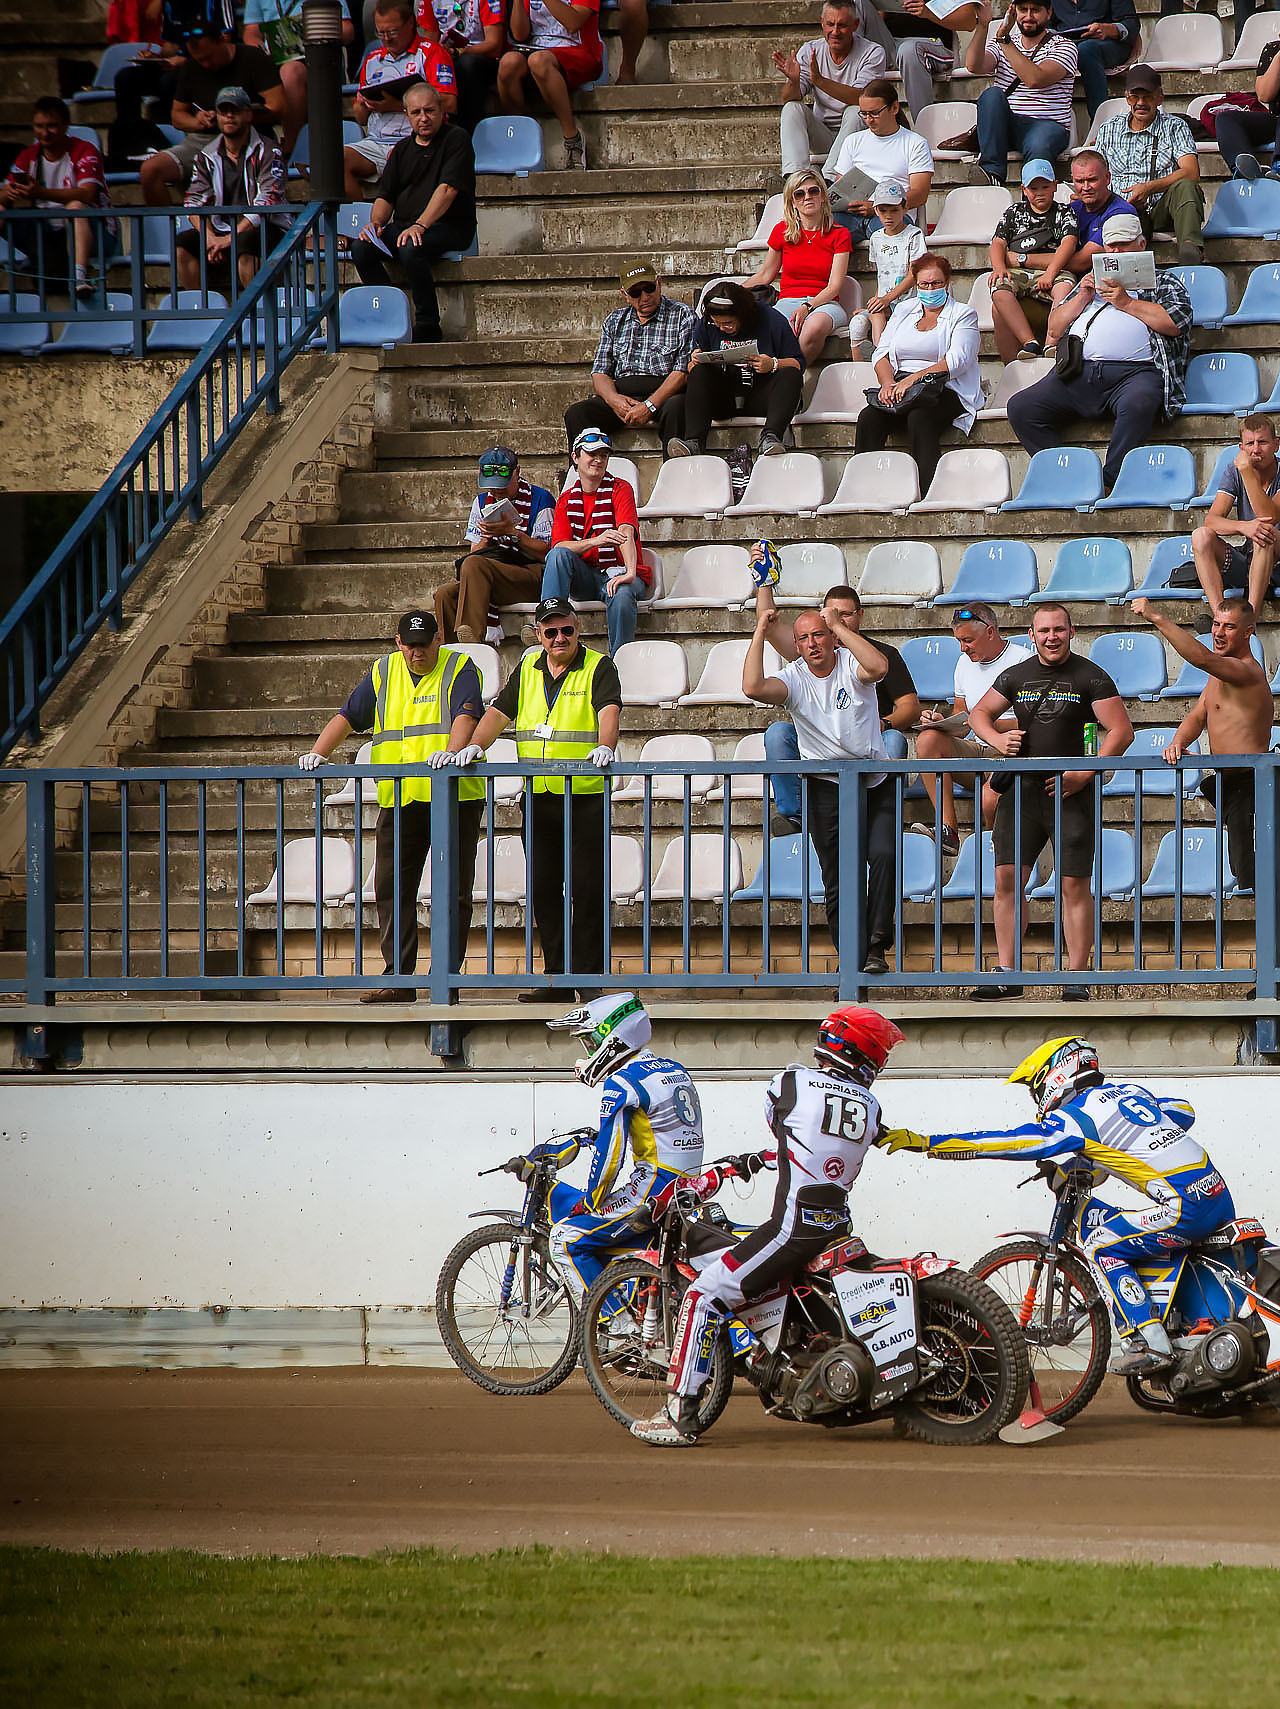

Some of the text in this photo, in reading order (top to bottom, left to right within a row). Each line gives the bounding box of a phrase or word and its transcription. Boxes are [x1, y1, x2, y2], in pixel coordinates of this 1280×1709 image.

[507, 126, 514, 138] 6
[1240, 185, 1251, 196] 41
[351, 214, 359, 227] 5
[372, 297, 380, 309] 6
[1210, 359, 1225, 370] 40
[1058, 455, 1068, 467] 41
[1149, 453, 1164, 465] 40
[989, 547, 1002, 560] 41
[1084, 544, 1099, 556] 40
[927, 641, 939, 654] 41
[1119, 639, 1133, 650] 39
[1151, 734, 1164, 747] 38
[1188, 838, 1203, 851] 37
[678, 1089, 696, 1125] 3
[1122, 1098, 1156, 1123] 5
[826, 1096, 868, 1141] 13
[860, 1304, 888, 1323] REALL
[889, 1329, 914, 1346] AUTO
